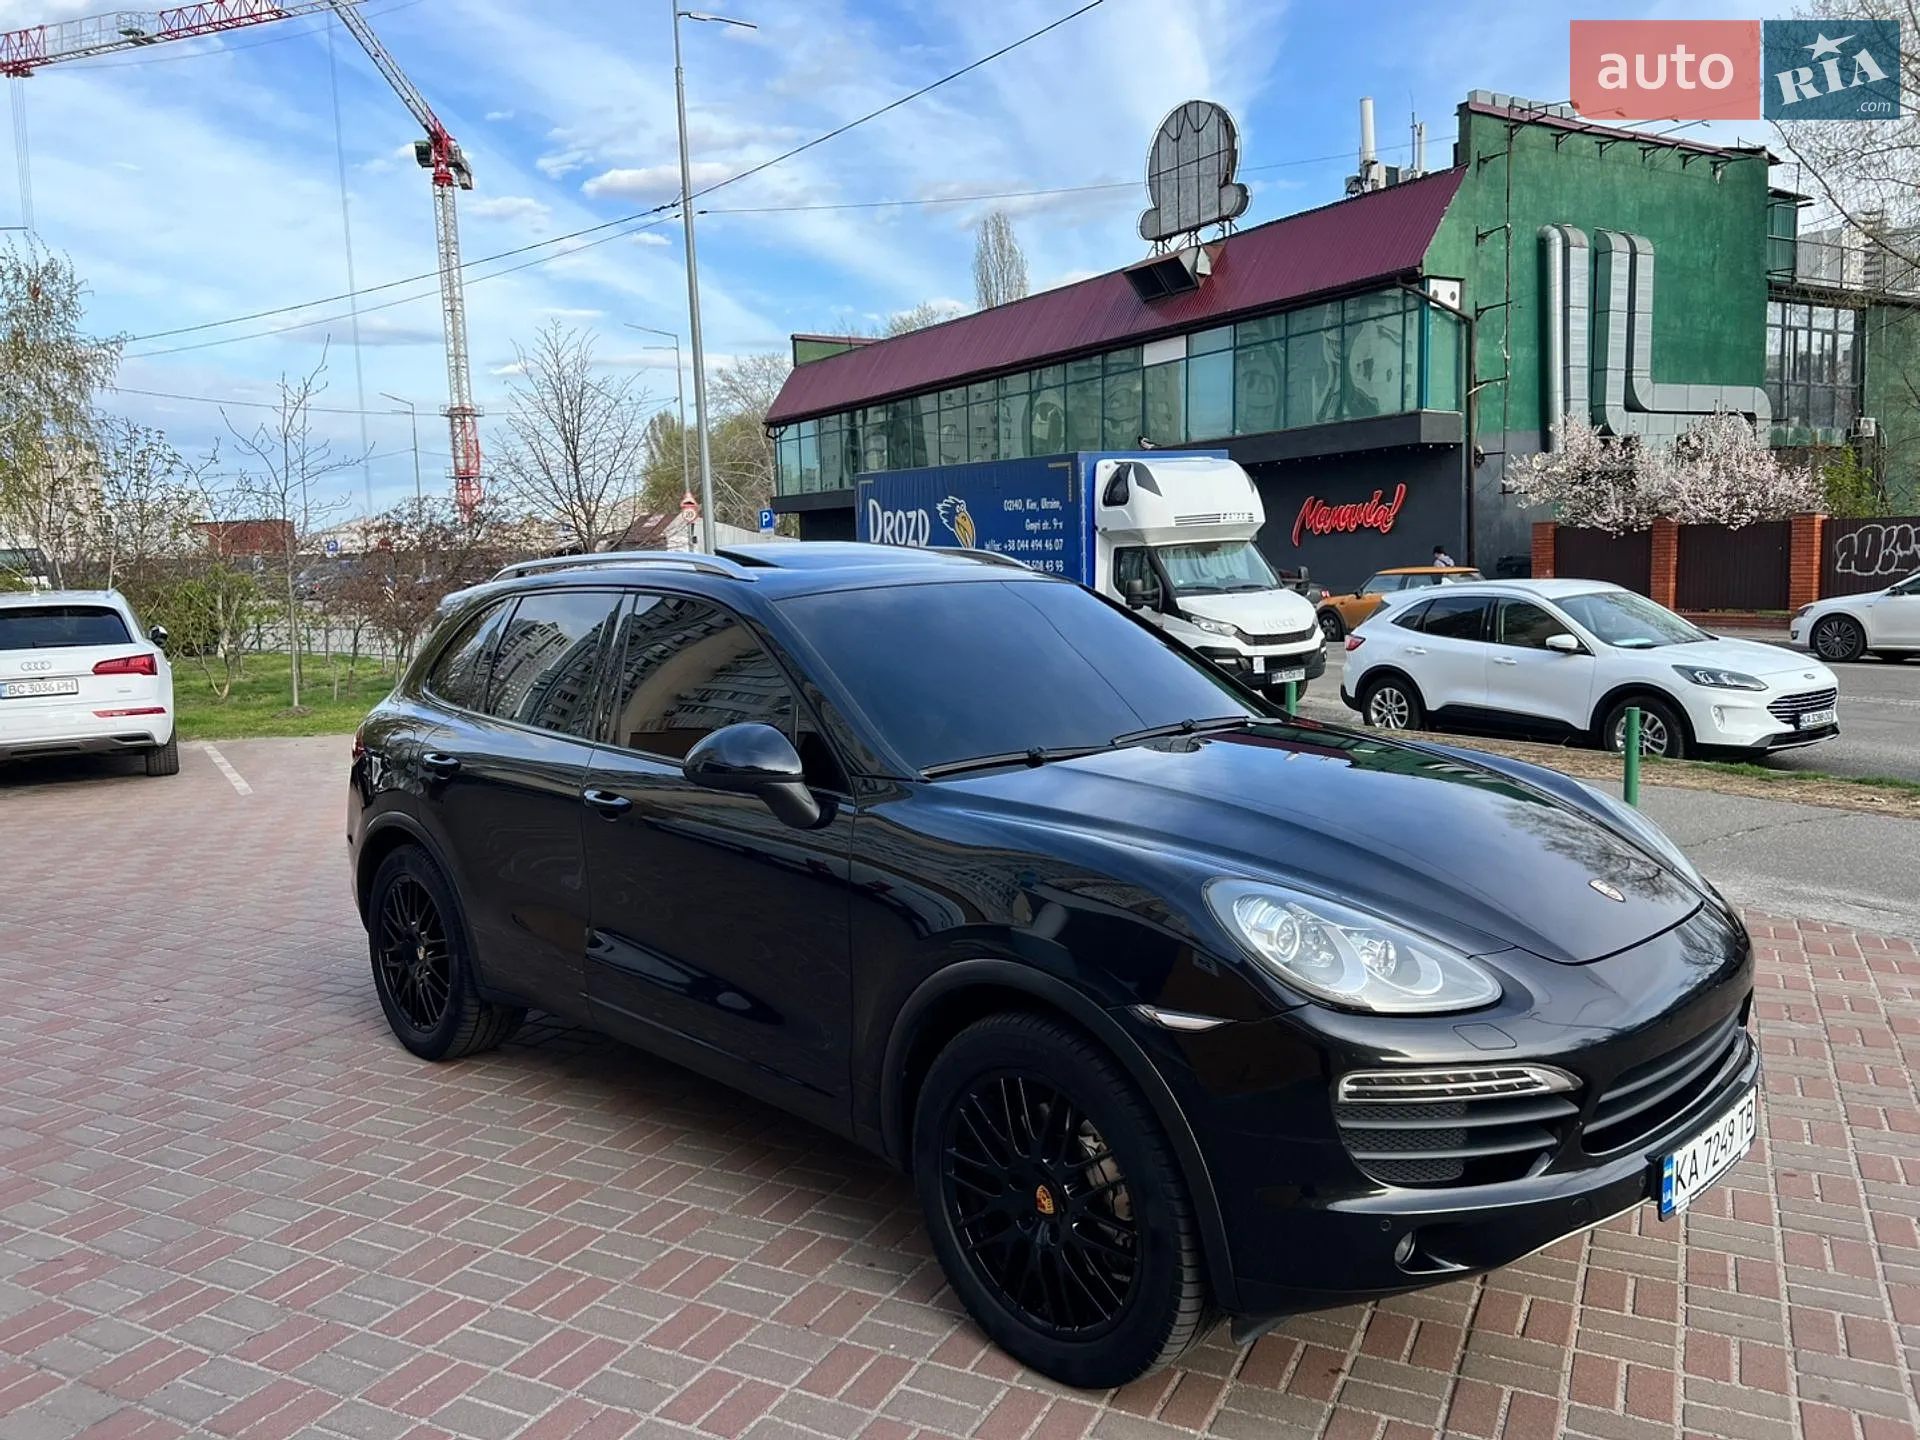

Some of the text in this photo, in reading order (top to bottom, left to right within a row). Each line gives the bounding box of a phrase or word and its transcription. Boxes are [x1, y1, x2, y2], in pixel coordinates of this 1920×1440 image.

[761, 511, 770, 526] P
[1003, 539, 1015, 551] +38
[1053, 538, 1063, 551] 07
[8, 684, 25, 696] BC
[56, 681, 74, 692] PH
[1675, 1101, 1753, 1195] KA 7249 TB
